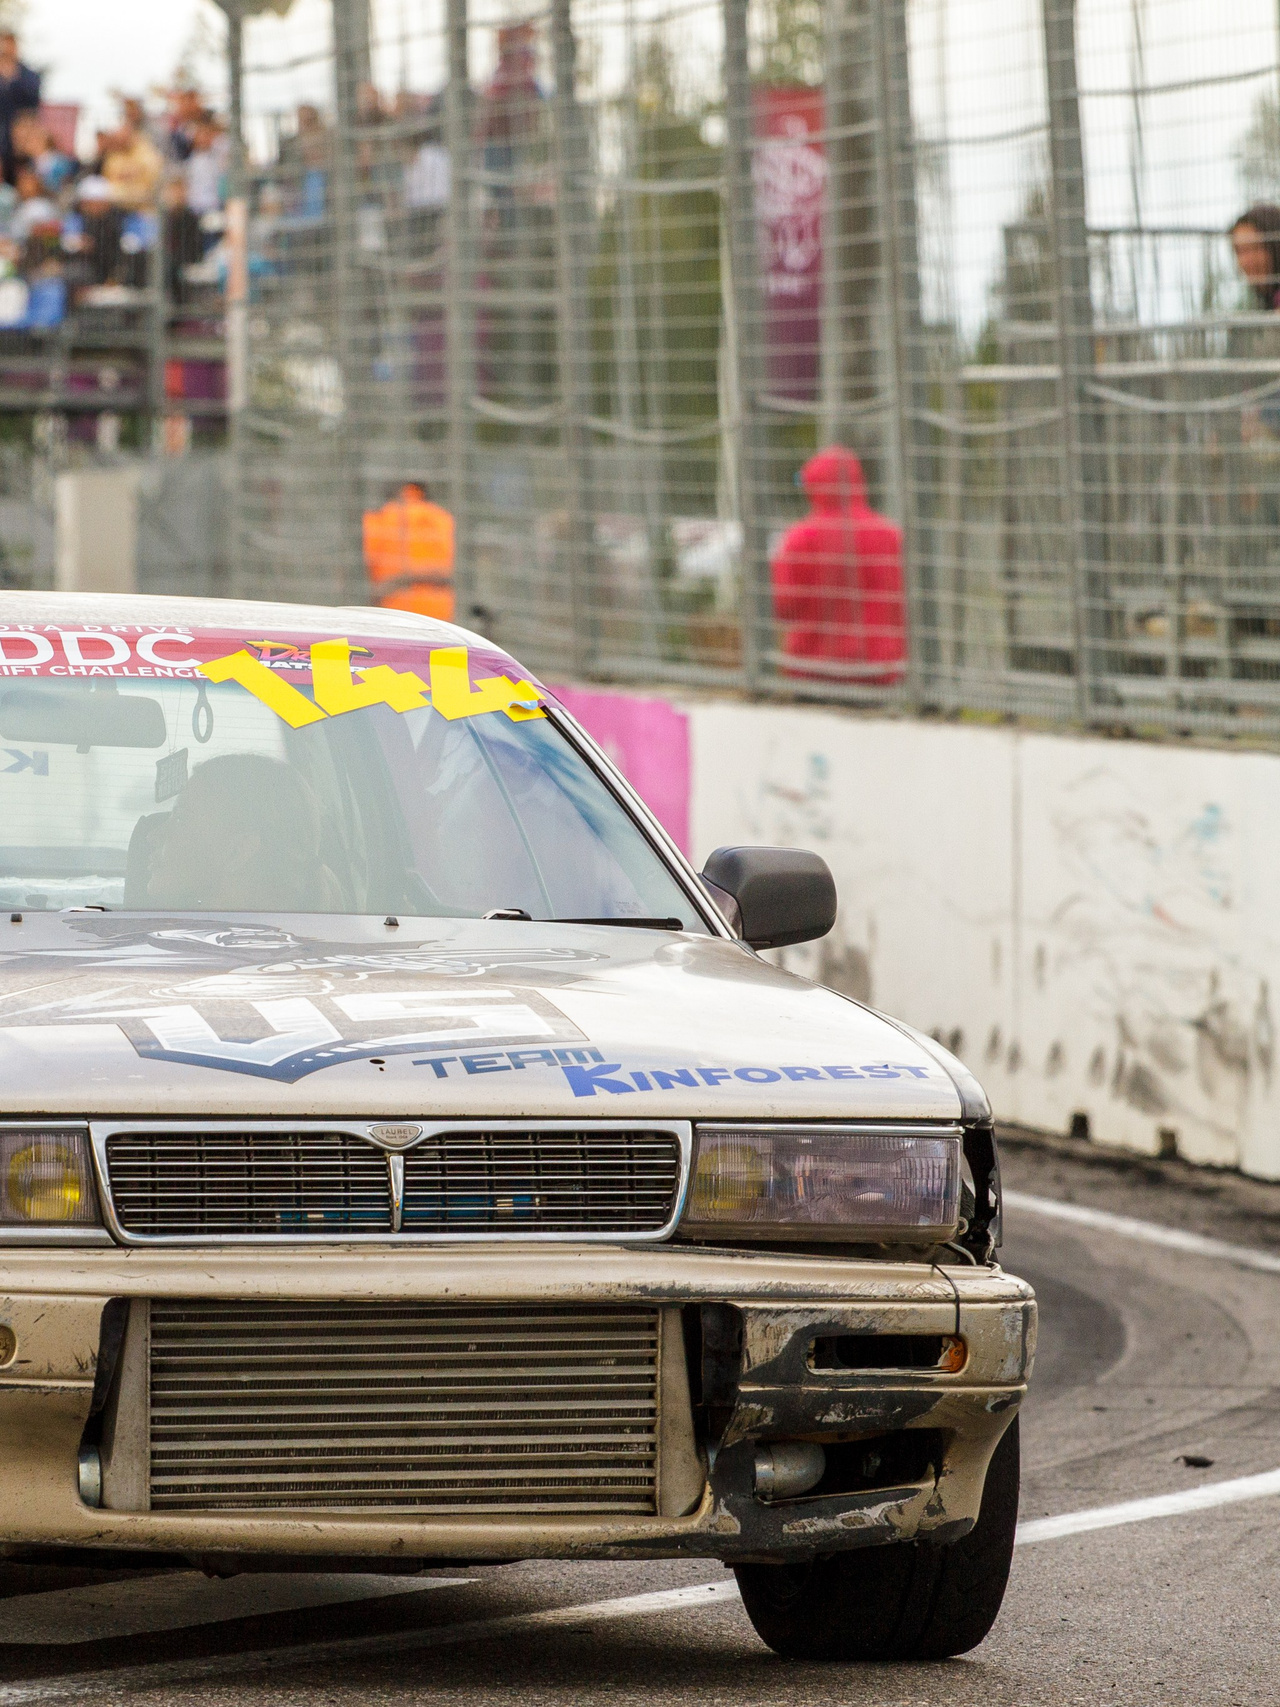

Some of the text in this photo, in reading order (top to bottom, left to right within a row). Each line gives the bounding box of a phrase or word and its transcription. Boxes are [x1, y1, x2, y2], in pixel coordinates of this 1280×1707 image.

[195, 637, 548, 730] 144
[412, 1046, 606, 1079] TEAM
[561, 1063, 930, 1098] KINFOREST
